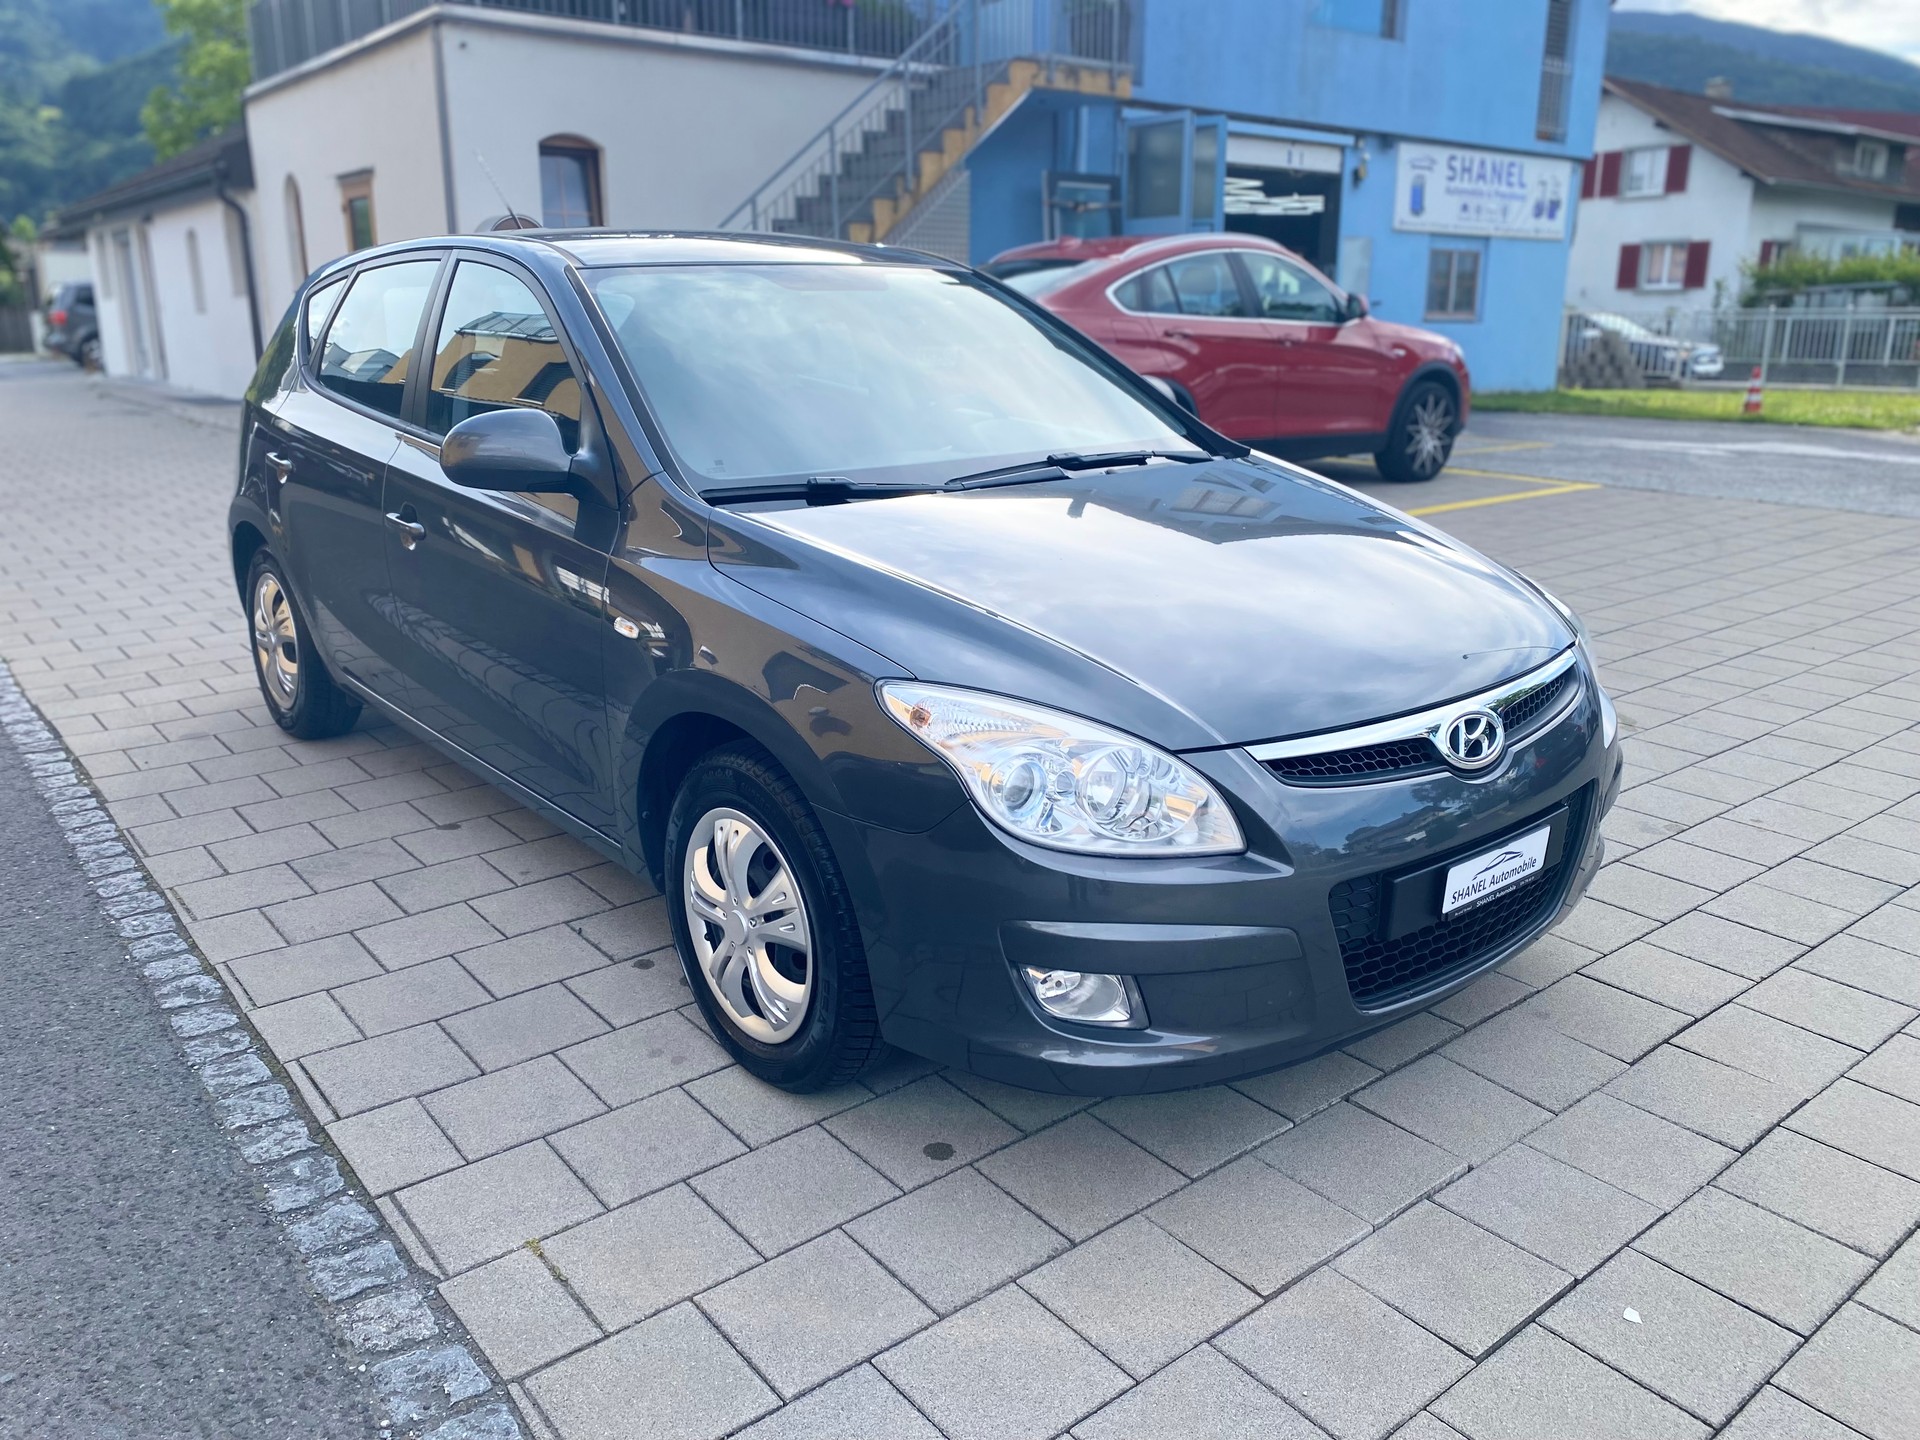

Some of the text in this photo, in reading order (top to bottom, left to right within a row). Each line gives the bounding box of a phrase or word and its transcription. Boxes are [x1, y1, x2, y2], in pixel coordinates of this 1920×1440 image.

[1446, 154, 1527, 189] SHANEL
[1451, 856, 1537, 905] SHANEL Automobile
[1476, 894, 1496, 908] SHANEL
